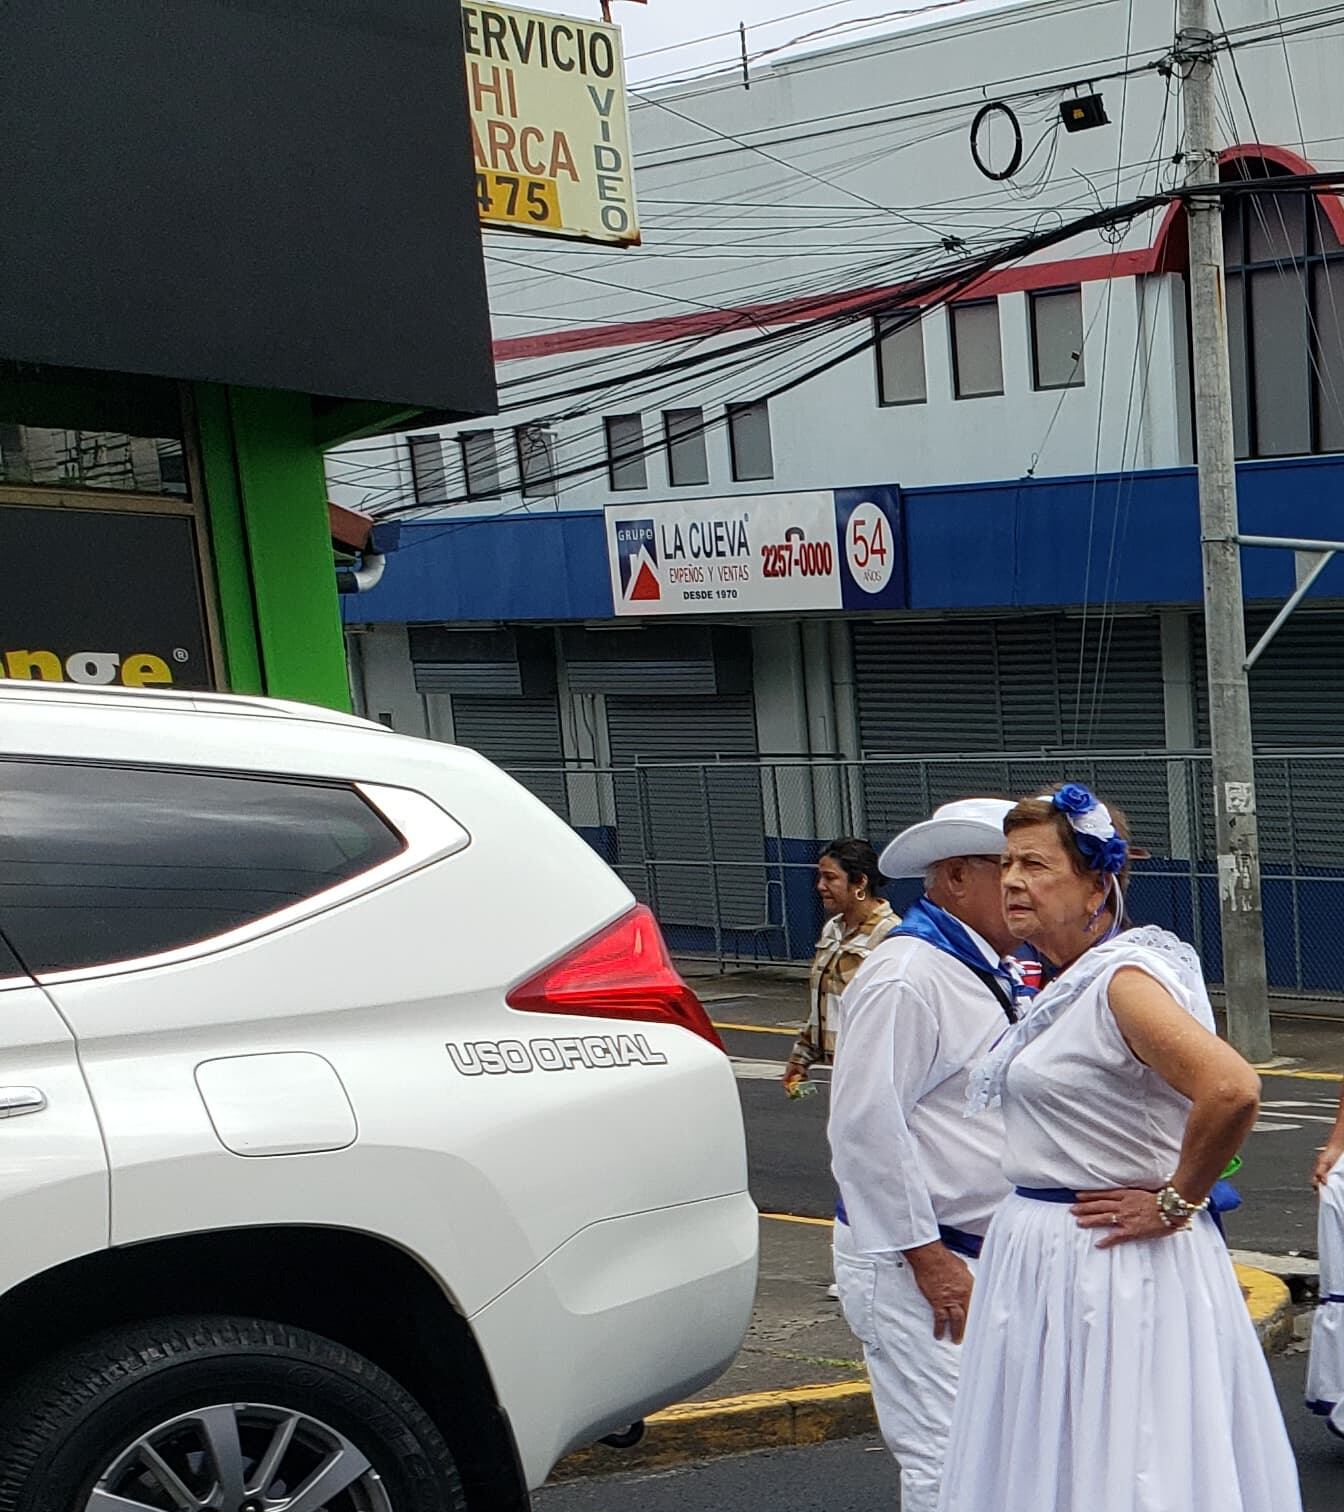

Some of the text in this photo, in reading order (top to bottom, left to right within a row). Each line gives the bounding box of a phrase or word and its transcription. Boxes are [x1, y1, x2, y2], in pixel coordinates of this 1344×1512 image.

[462, 7, 614, 78] ERVICIO
[471, 62, 518, 118] HI
[587, 85, 628, 232] VIDEO
[477, 173, 550, 221] 475
[618, 529, 653, 541] GRUPO
[661, 519, 750, 559] LA CUEVA
[852, 517, 887, 568] 54
[669, 564, 749, 583] EMPEÑOS Y VENTAS
[761, 541, 832, 578] 2257-0000
[683, 590, 737, 600] DESDE 1970
[0, 650, 174, 687] nge
[446, 1034, 668, 1077] USO OFICIAL
